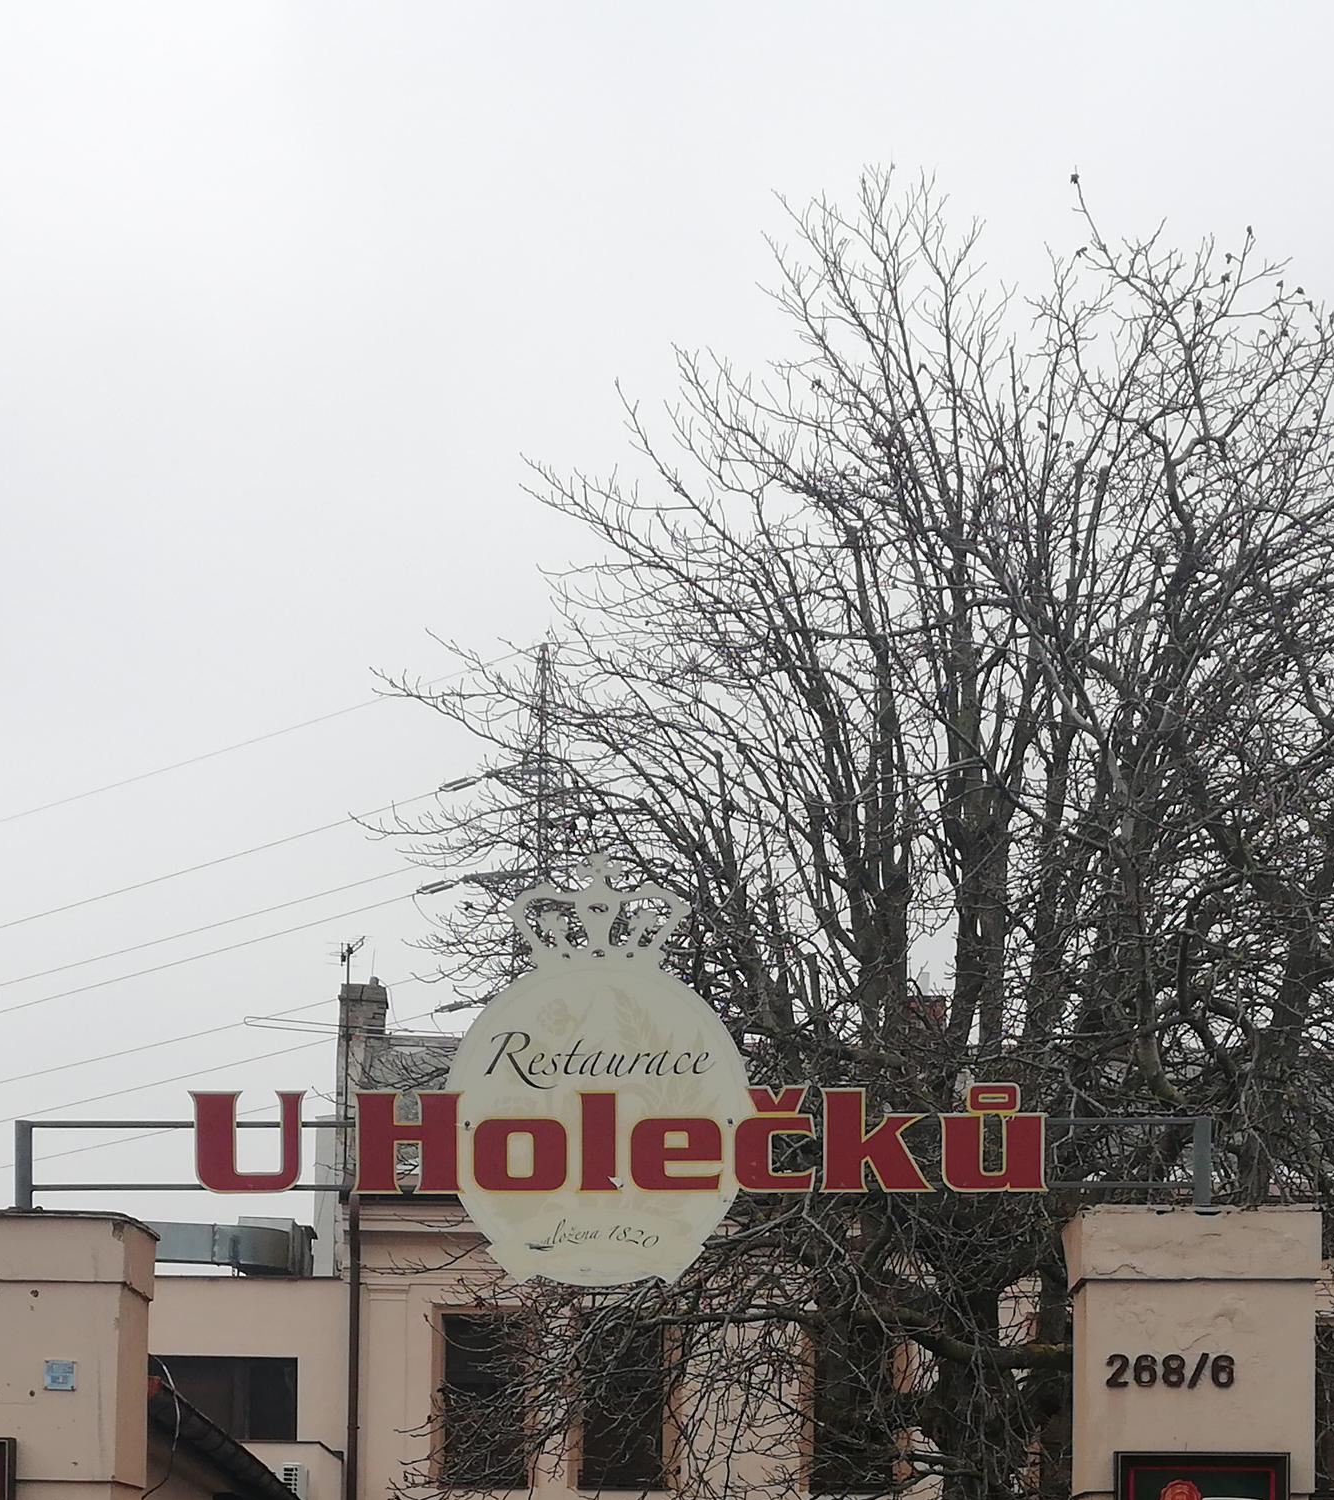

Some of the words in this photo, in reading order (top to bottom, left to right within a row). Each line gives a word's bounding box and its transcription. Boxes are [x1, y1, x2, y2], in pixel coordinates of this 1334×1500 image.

[484, 1031, 716, 1090] Restaurace
[187, 1090, 307, 1194] U
[351, 1082, 1048, 1194] Holečků
[608, 1225, 659, 1248] 1820
[1105, 1352, 1235, 1389] 268/6
